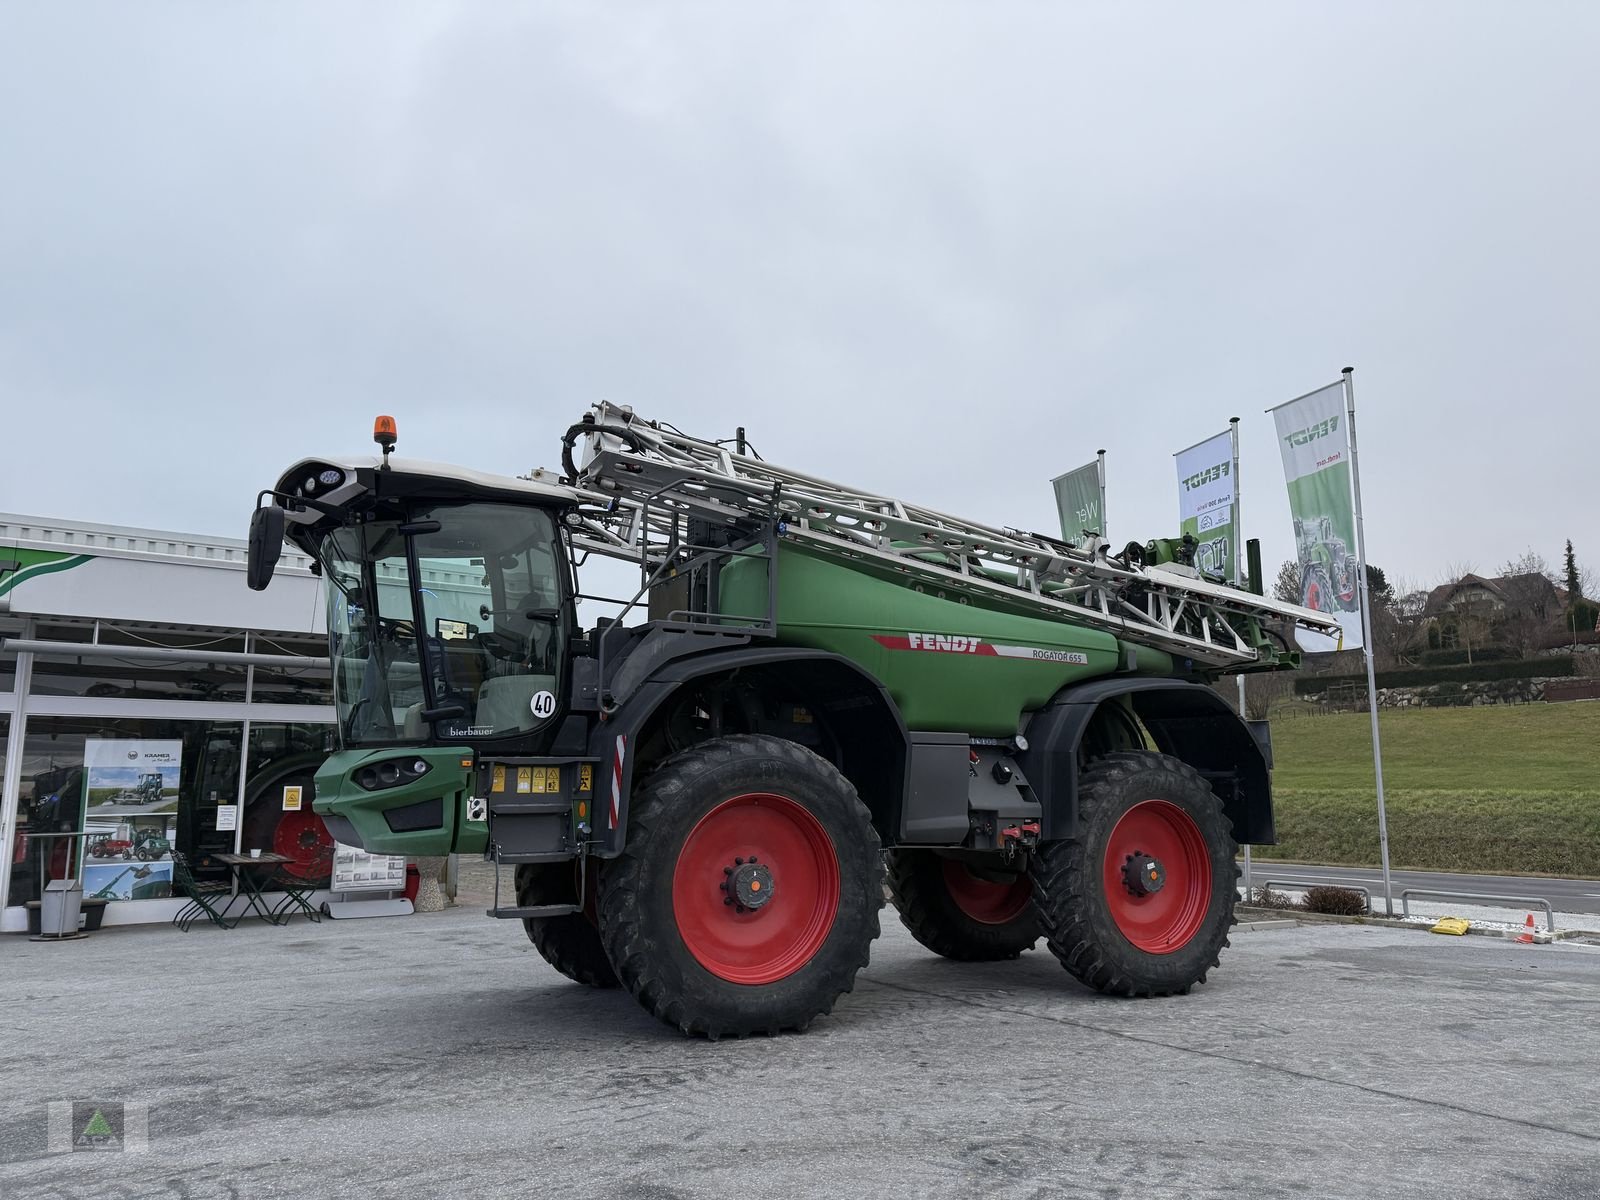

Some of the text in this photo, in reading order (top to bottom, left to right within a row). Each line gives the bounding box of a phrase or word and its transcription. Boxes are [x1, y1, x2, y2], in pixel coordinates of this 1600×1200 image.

[907, 632, 982, 653] FENDT
[1032, 649, 1082, 663] ROGATOR 655
[534, 694, 552, 714] 40
[450, 726, 494, 737] bierbauer
